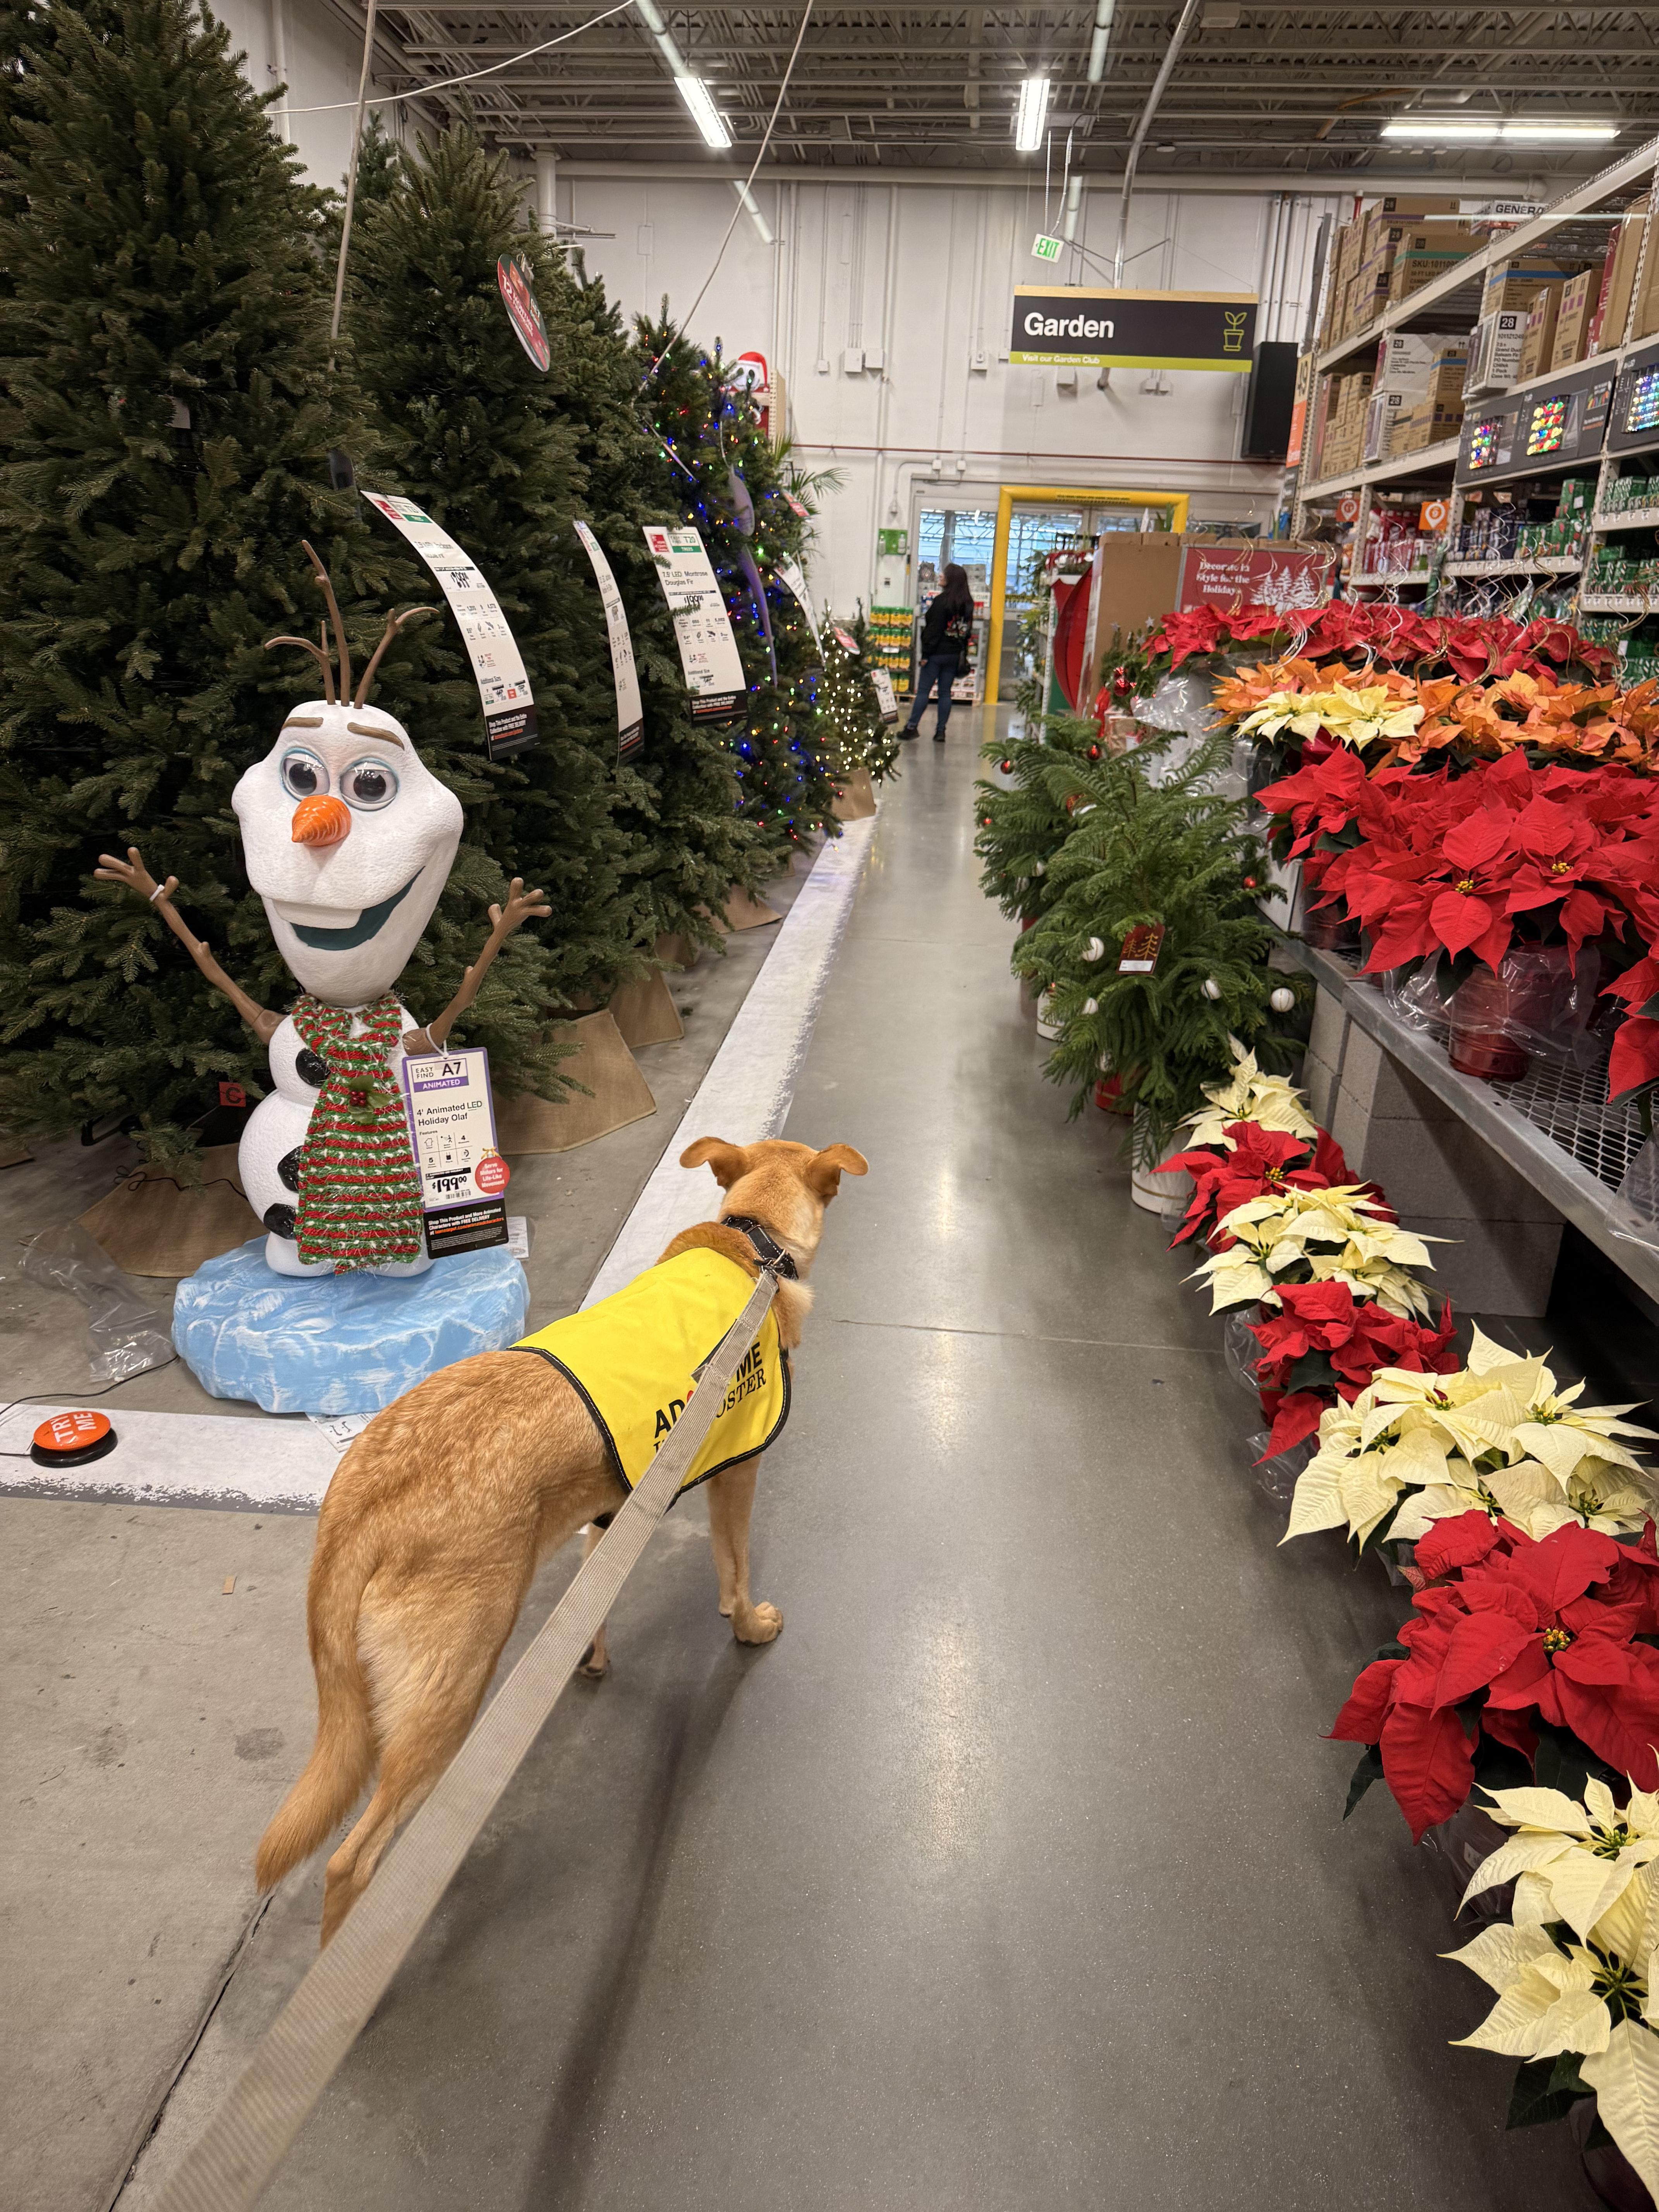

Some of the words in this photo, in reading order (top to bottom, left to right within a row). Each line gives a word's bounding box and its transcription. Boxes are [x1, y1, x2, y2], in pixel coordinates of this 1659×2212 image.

[1037, 238, 1060, 259] EXIT
[1024, 312, 1115, 338] Garden
[1501, 318, 1515, 328] 28
[1082, 356, 1100, 364] Club
[1200, 562, 1239, 571] Decorate
[1240, 563, 1250, 572] in
[1196, 574, 1218, 583] Style
[1235, 575, 1250, 584] the
[442, 1062, 461, 1076] A7
[423, 1079, 460, 1090] ANIMATED
[226, 1087, 241, 1104] C
[427, 1103, 465, 1115] Animated
[467, 1101, 482, 1109] LED
[419, 1116, 449, 1126] Holiday
[50, 1415, 74, 1443] TRY
[73, 1413, 96, 1431] ME
